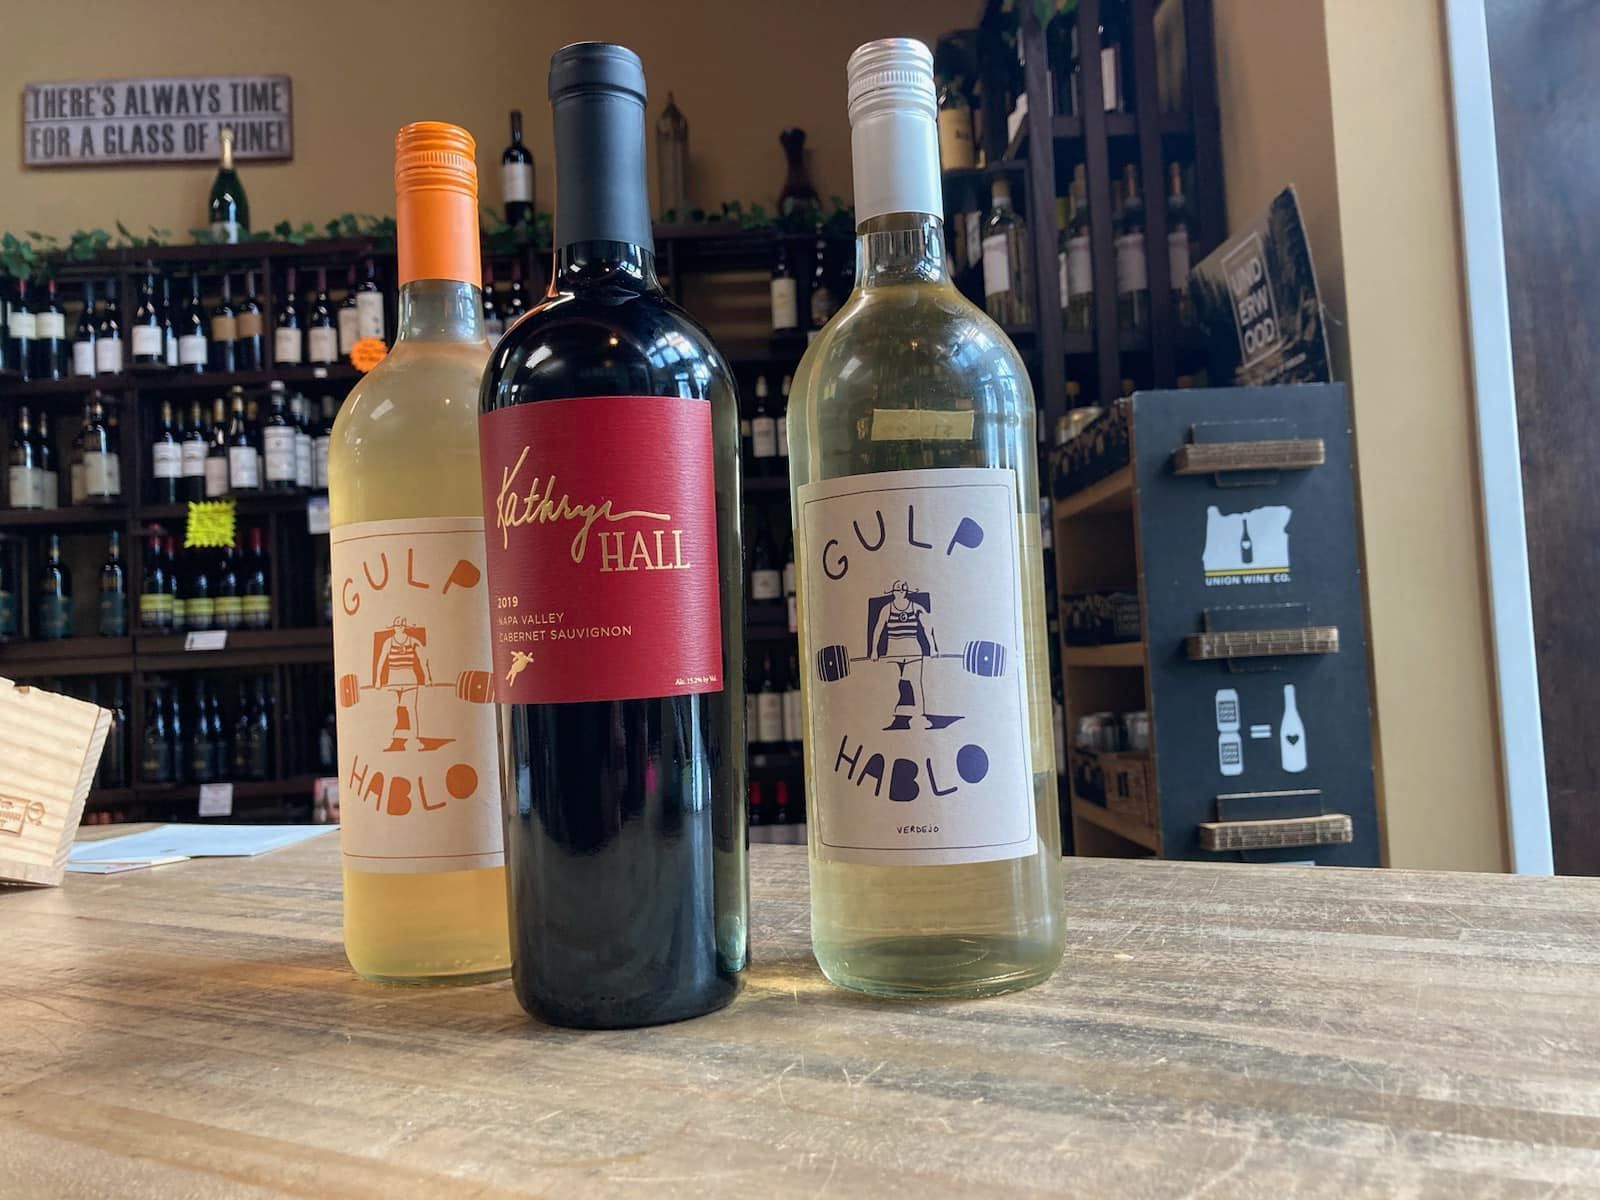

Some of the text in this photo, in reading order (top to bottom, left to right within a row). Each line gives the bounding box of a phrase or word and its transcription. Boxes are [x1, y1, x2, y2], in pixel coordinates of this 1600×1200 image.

[31, 80, 282, 120] THERE'S ALWAYS TIME
[30, 125, 70, 159] FOR
[80, 125, 97, 157] A
[103, 122, 175, 155] GLASS
[184, 121, 209, 153] OF
[1231, 257, 1263, 297] UND
[1237, 284, 1269, 326] ERW
[1244, 317, 1276, 354] OOD
[497, 446, 670, 563] Kathryn
[598, 529, 691, 573] HALL
[823, 505, 985, 580] GULP
[343, 548, 482, 616] GULP
[1205, 575, 1241, 587] UNION
[1242, 573, 1272, 585] WINE
[498, 595, 519, 609] 2019
[521, 612, 565, 625] VALLEY
[499, 625, 632, 643] CABERNET SAUVIGNON
[350, 755, 478, 816] HABLO
[834, 735, 989, 802] HABLO
[896, 824, 940, 834] VERDEJO
